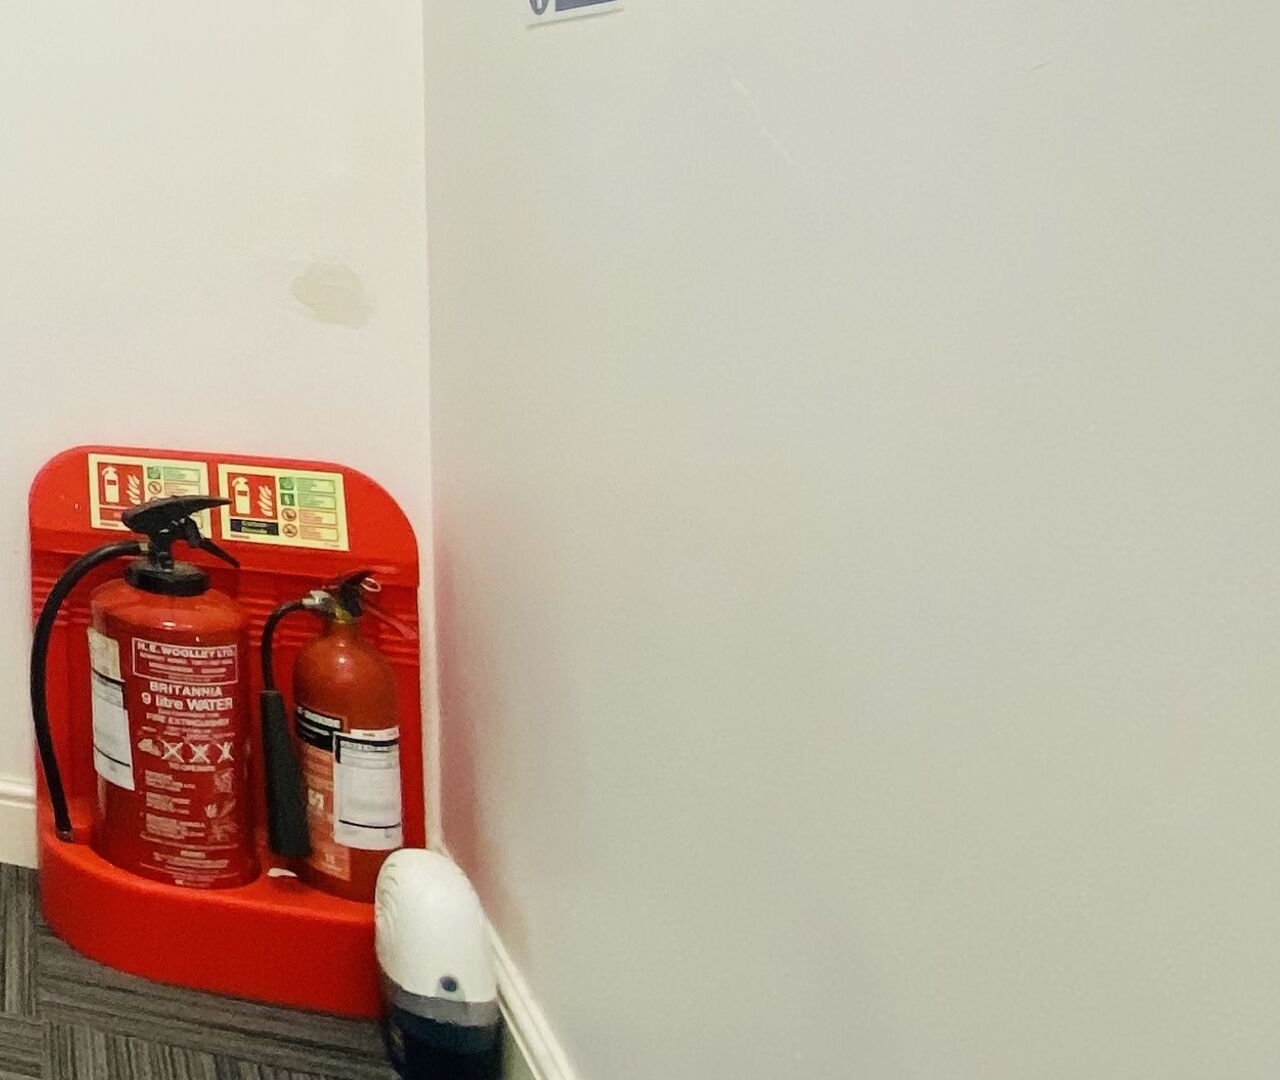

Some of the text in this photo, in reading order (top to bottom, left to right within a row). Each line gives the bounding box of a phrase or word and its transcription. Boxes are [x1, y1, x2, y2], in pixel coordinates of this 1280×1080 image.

[149, 680, 223, 697] BRITANNIA
[141, 692, 233, 712] 9 litre WATER
